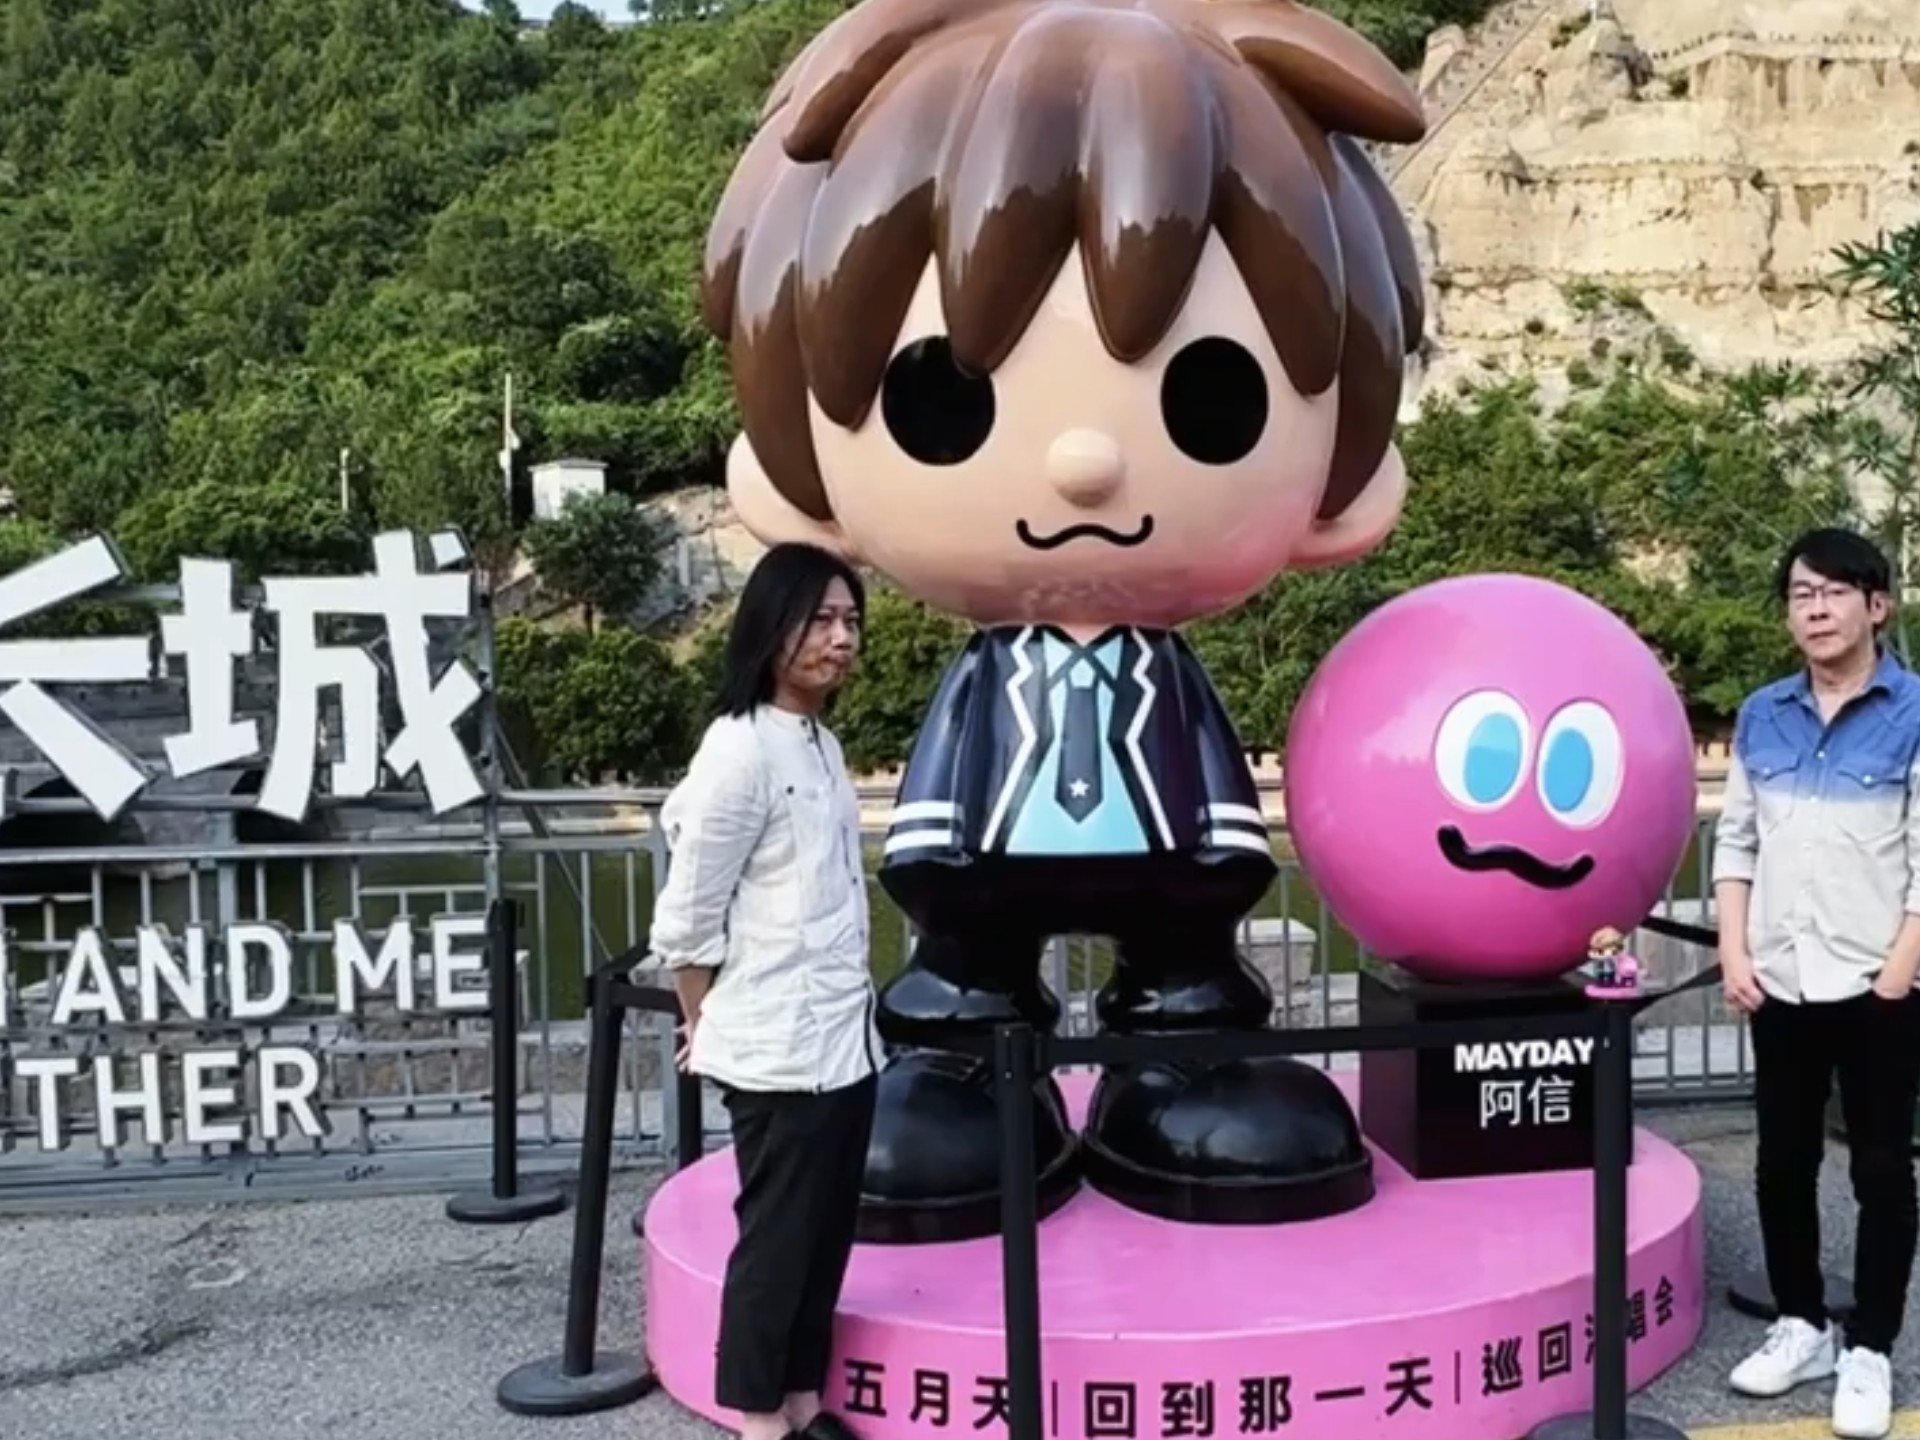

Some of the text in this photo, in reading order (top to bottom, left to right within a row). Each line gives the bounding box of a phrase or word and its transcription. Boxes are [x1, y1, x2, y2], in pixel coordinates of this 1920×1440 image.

[53, 925, 290, 1024] AND
[333, 918, 490, 1013] ME
[1454, 1036, 1594, 1073] MAYDAY
[1480, 1074, 1574, 1129] 阿信
